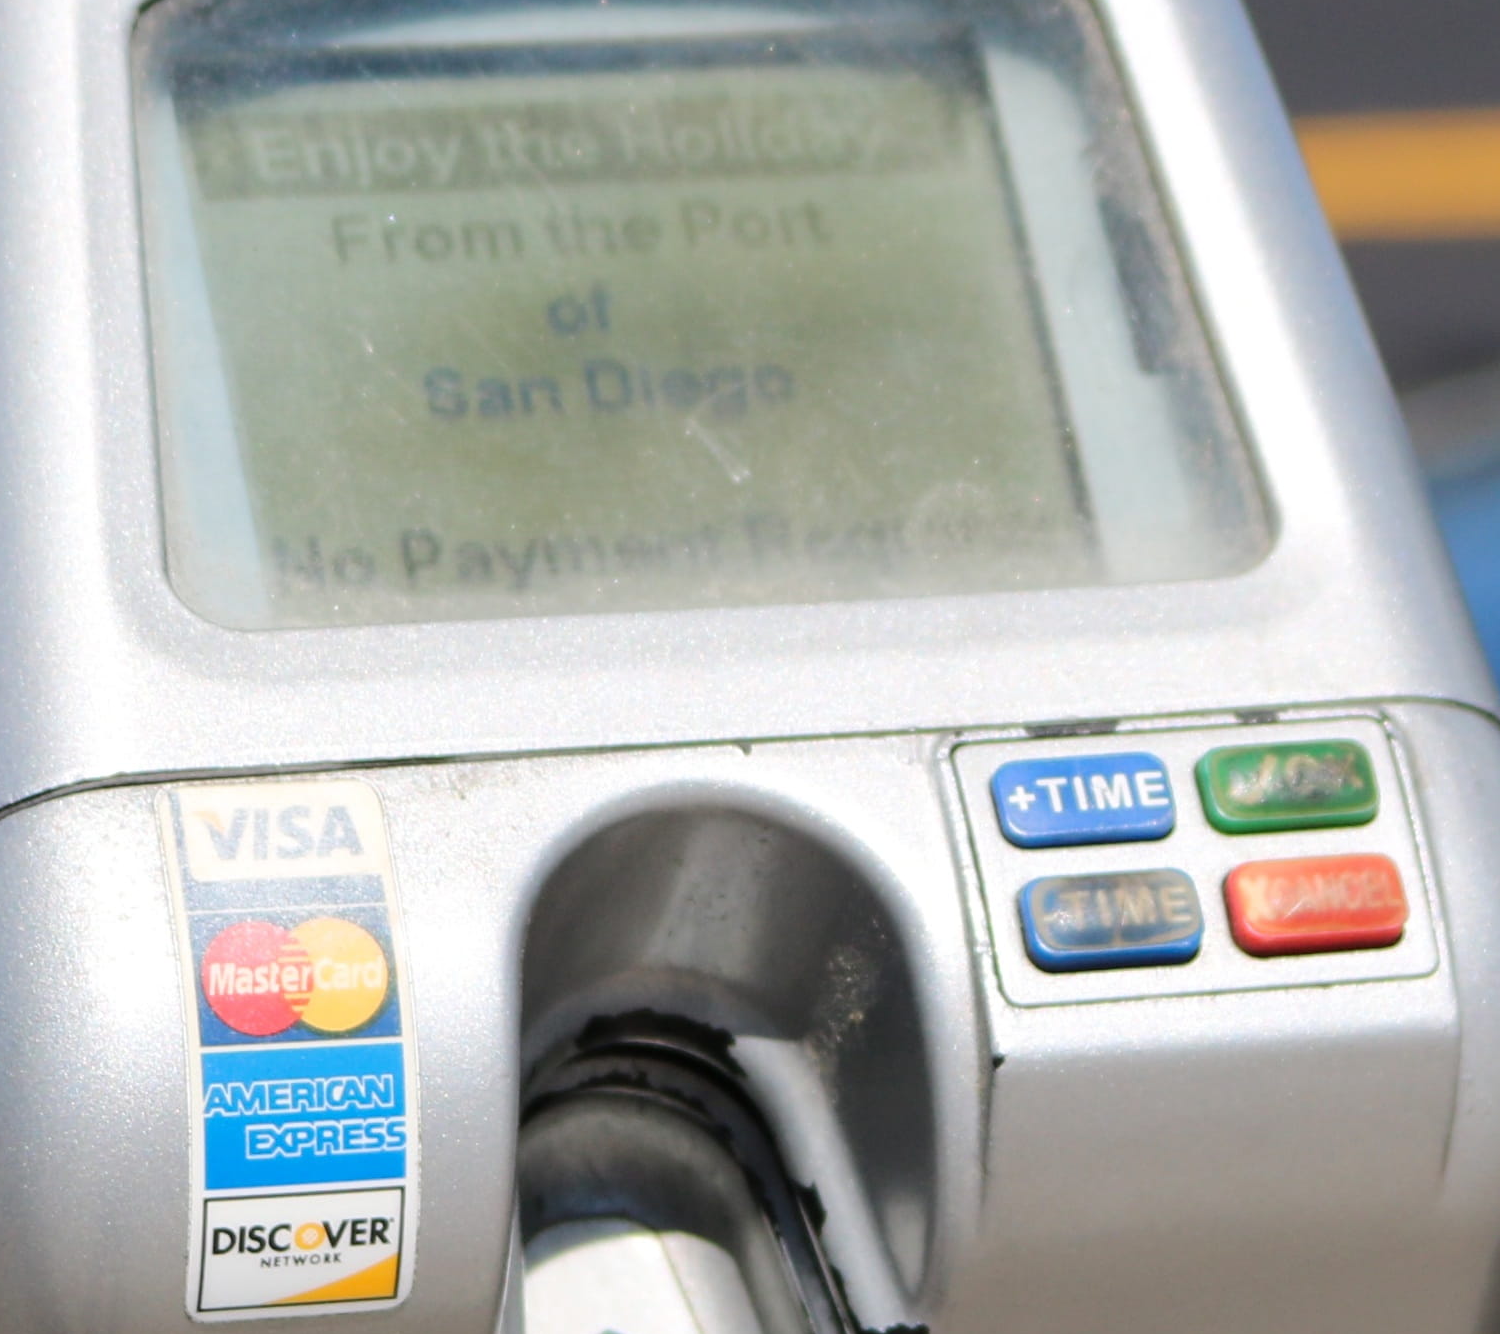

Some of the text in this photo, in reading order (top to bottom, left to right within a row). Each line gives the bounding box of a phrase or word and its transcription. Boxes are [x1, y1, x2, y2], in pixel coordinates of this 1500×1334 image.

[250, 105, 884, 187] Enjoy the Holiday
[330, 196, 832, 267] From the Port
[545, 283, 611, 336] of
[424, 359, 796, 421] San Diego
[275, 530, 375, 585] No
[398, 518, 721, 590] Payment
[1008, 771, 1169, 814] +TIME
[193, 804, 365, 861] VISA
[209, 958, 382, 997] MasterCard
[204, 1074, 394, 1117] AMERICAN
[246, 1118, 407, 1159] EXPRESS
[212, 1218, 390, 1256] DISCOVER
[260, 1252, 343, 1269] NETWORK
